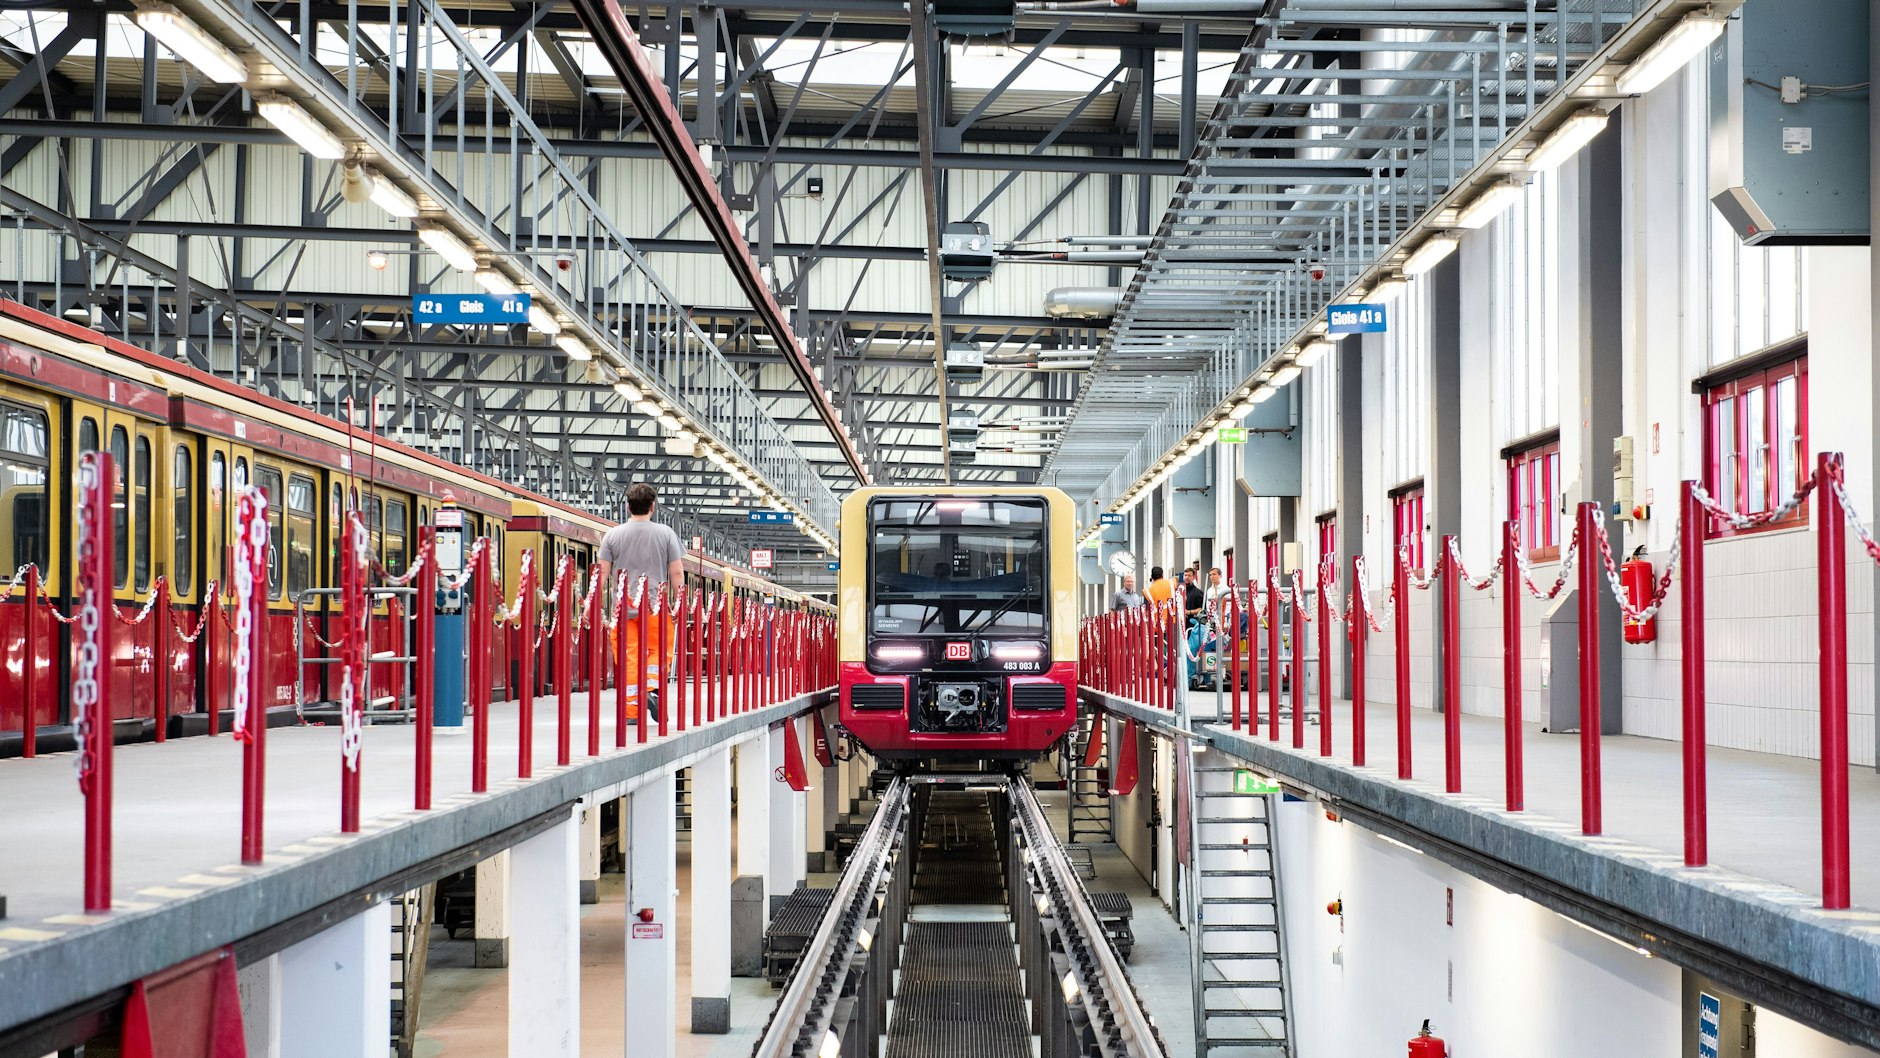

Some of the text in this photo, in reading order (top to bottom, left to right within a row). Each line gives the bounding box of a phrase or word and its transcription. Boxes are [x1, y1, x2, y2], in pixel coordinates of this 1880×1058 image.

[419, 300, 523, 313] 42 a Gleis 41 a
[1331, 310, 1382, 325] Gleis 41 a
[950, 645, 968, 657] DB
[1003, 662, 1040, 670] 483 003 A
[1700, 1003, 1718, 1029] Achtung
